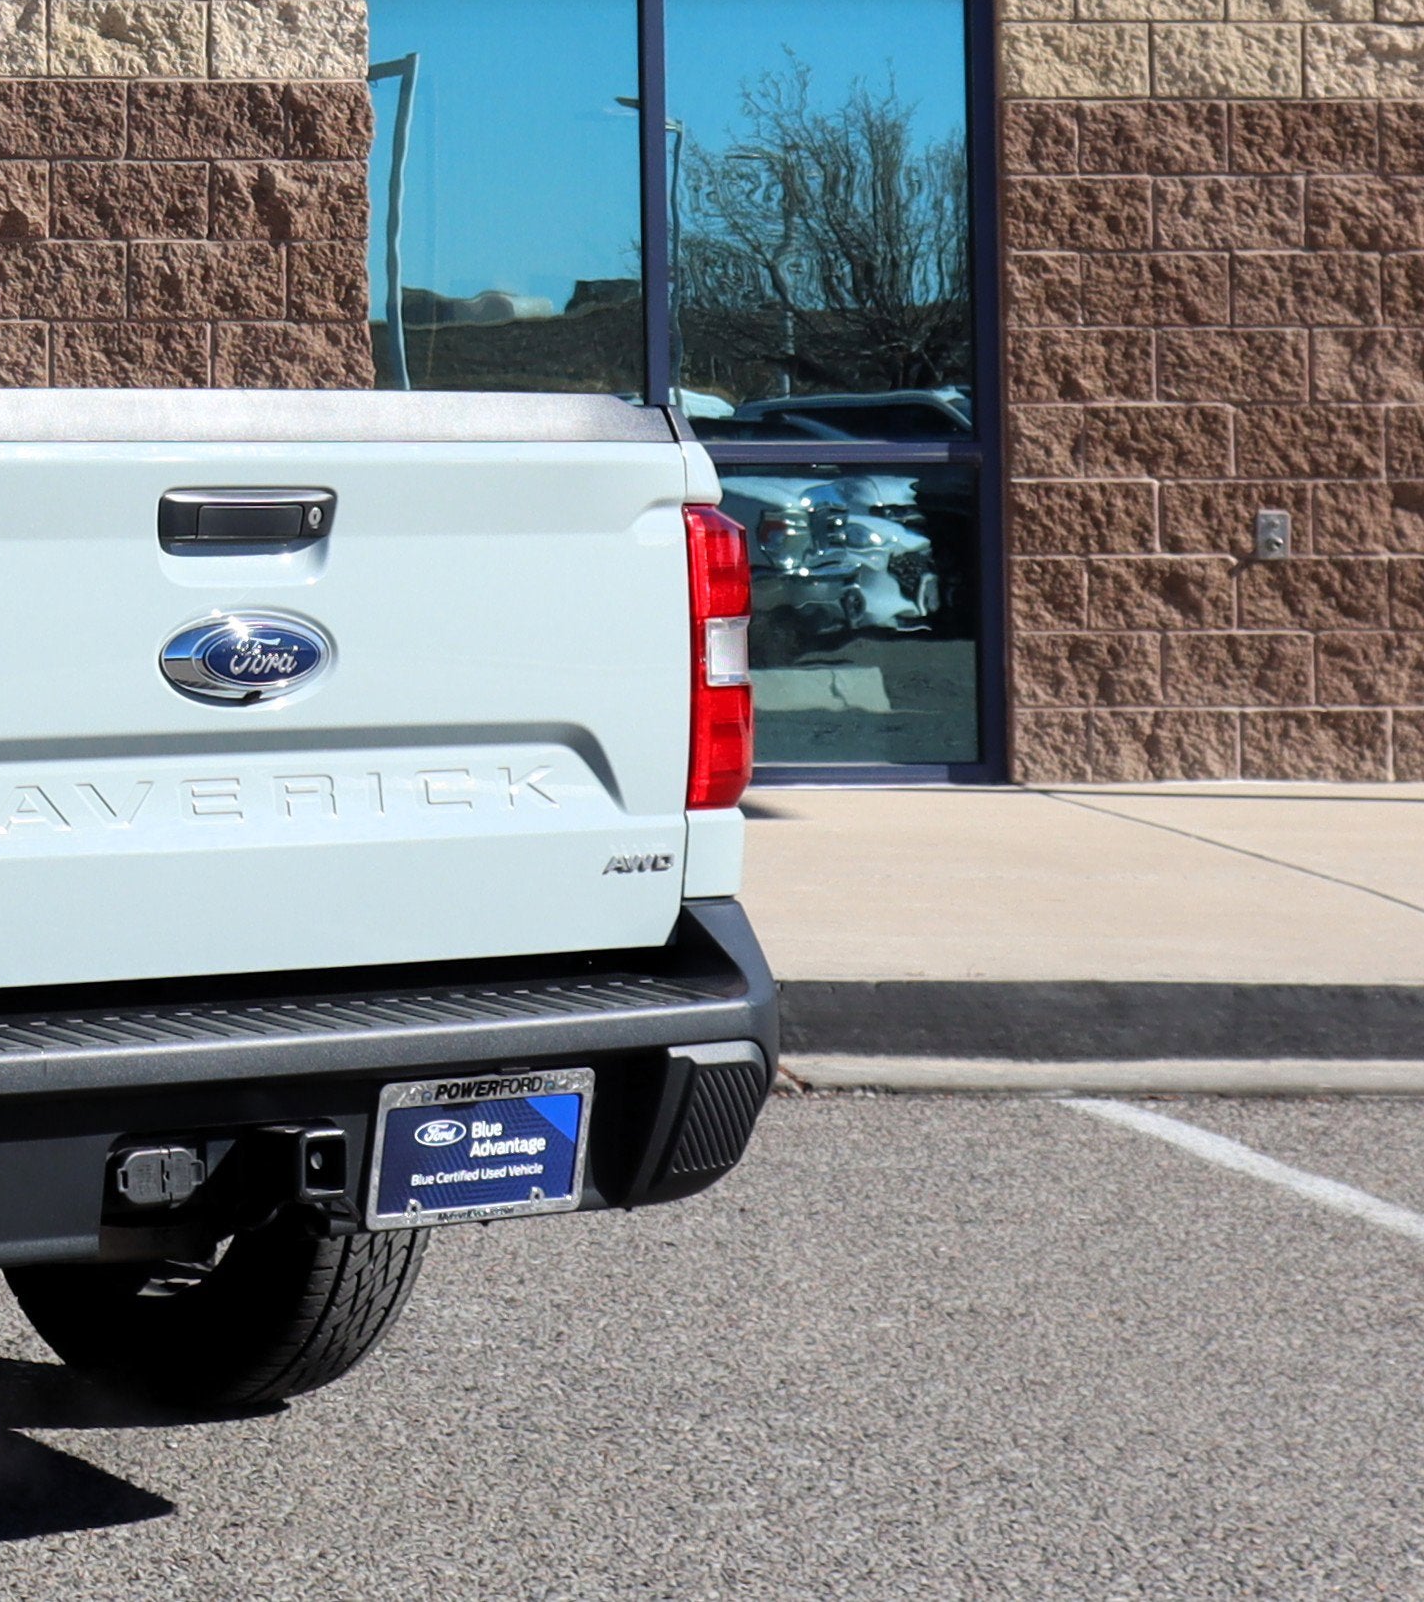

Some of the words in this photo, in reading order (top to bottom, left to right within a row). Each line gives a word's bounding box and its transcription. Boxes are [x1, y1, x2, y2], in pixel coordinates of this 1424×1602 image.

[229, 635, 298, 675] Ford
[602, 853, 675, 875] AWD
[434, 1077, 543, 1100] POWERFORD
[424, 1124, 457, 1142] Ford
[472, 1121, 503, 1138] Blue
[470, 1137, 547, 1158] Advantage
[411, 1173, 435, 1186] Blue
[436, 1168, 480, 1184] Certified
[480, 1165, 507, 1179] Used
[507, 1162, 544, 1177] Vehicle
